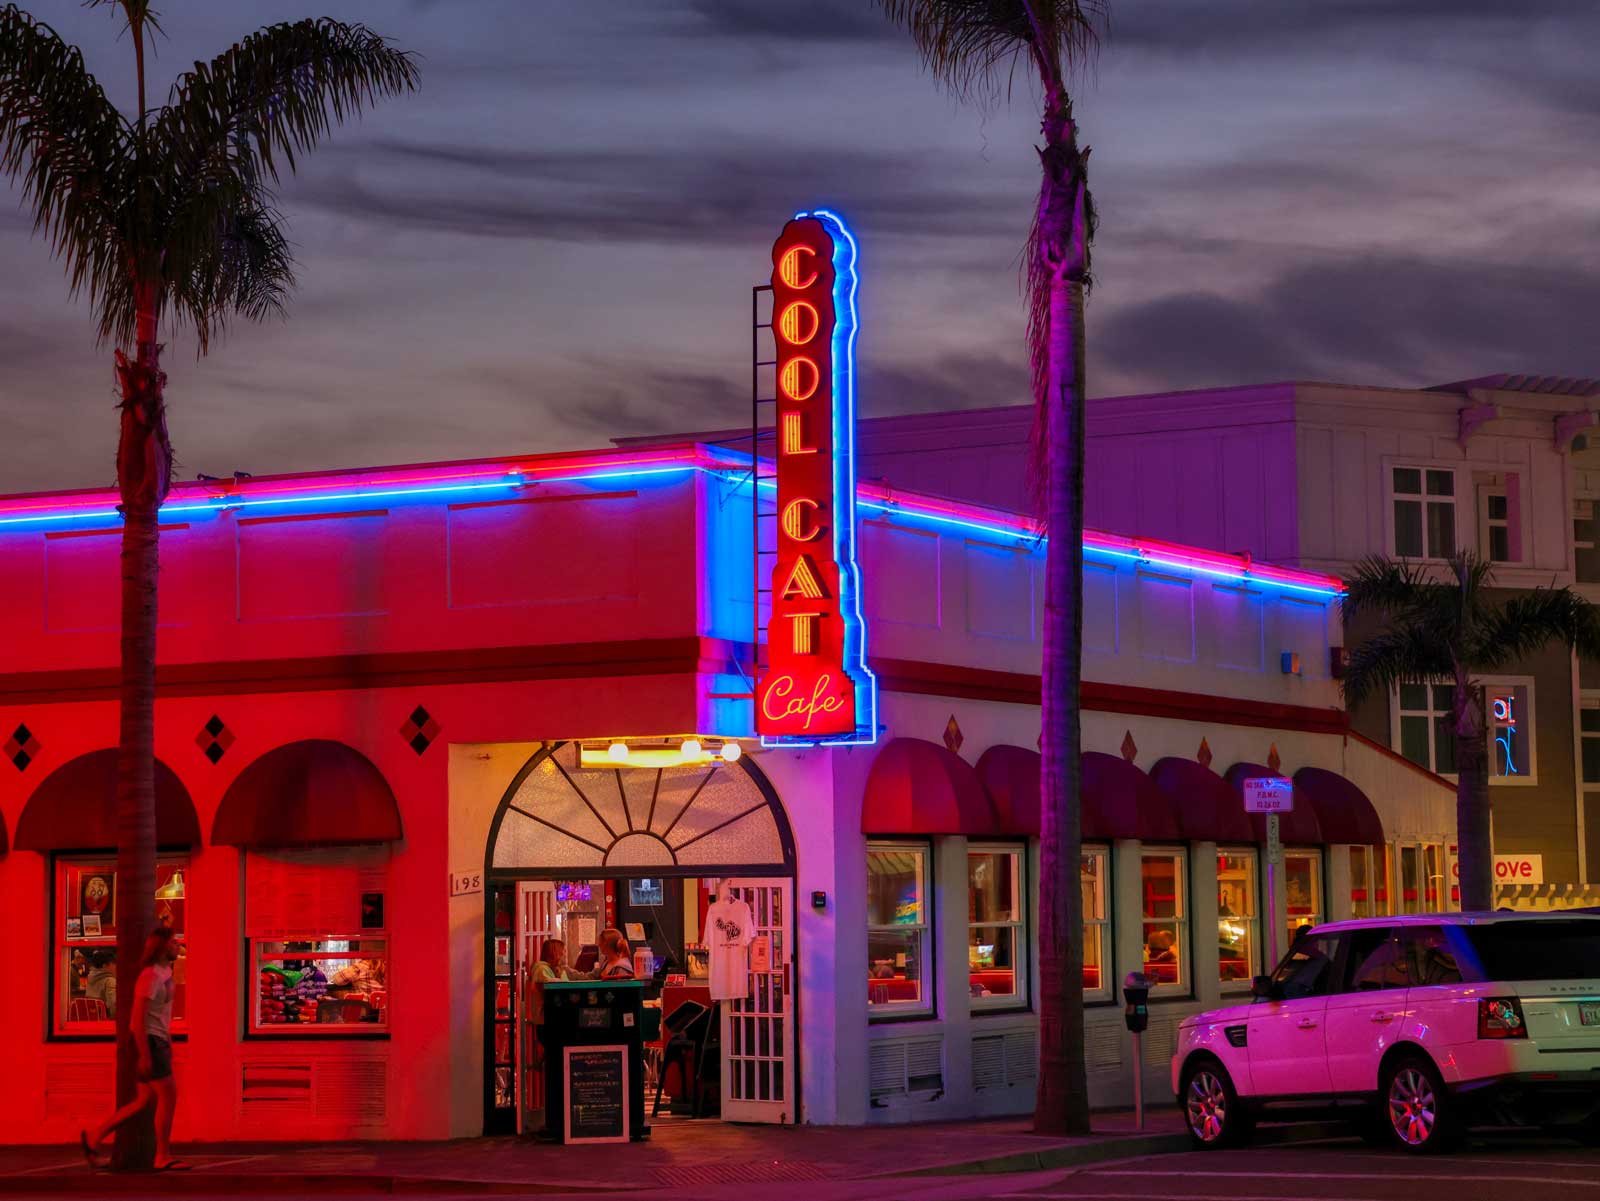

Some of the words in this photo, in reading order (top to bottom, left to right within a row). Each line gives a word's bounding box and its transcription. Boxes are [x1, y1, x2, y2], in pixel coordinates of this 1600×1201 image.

[779, 245, 819, 455] COOL
[780, 497, 824, 655] CAT
[762, 674, 845, 729] Cafe
[455, 875, 480, 891] 198
[1495, 861, 1532, 878] ove
